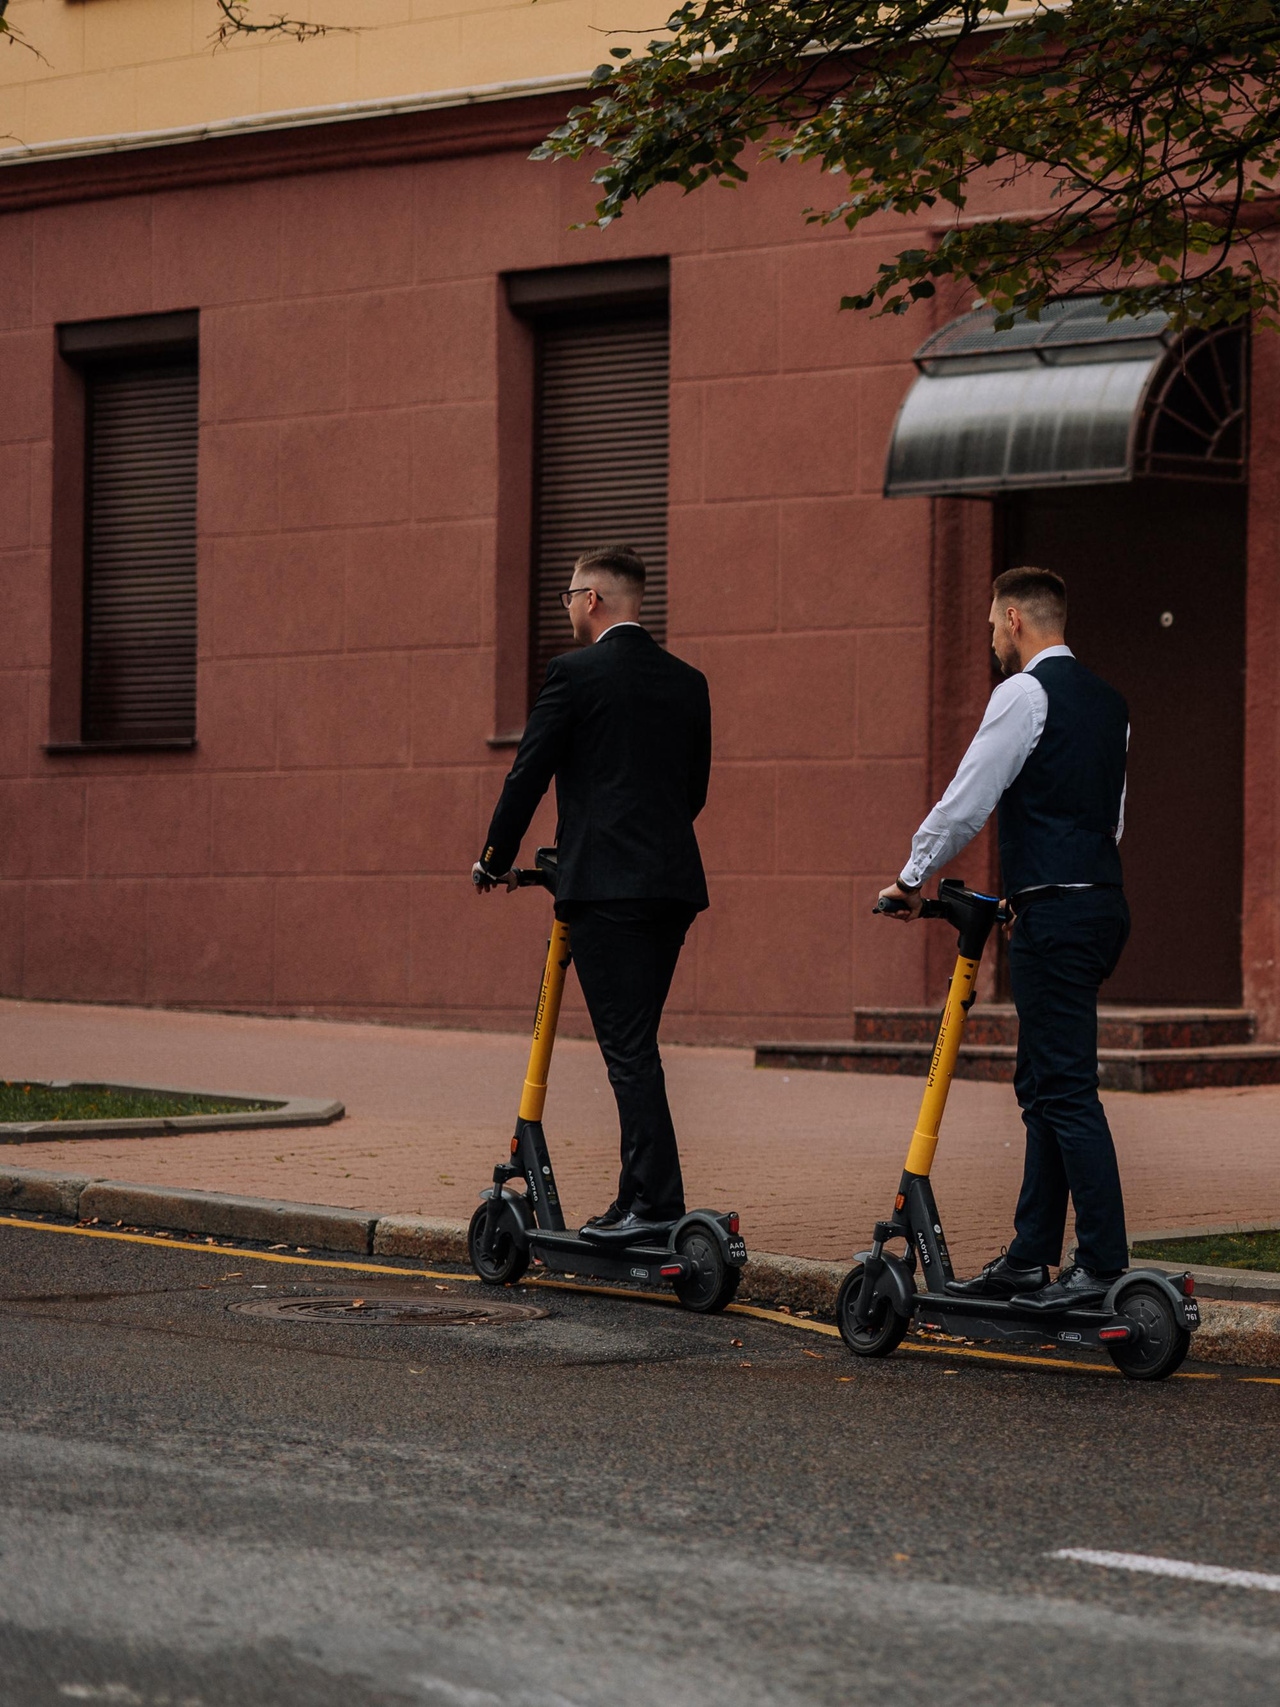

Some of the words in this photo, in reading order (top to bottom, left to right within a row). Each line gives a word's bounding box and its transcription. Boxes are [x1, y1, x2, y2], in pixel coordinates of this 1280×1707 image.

[534, 985, 548, 1040] WHOOSH
[927, 1027, 947, 1088] WHOOSH
[731, 1250, 746, 1258] 760
[917, 1232, 930, 1264] AA0761
[1186, 1312, 1198, 1321] 761
